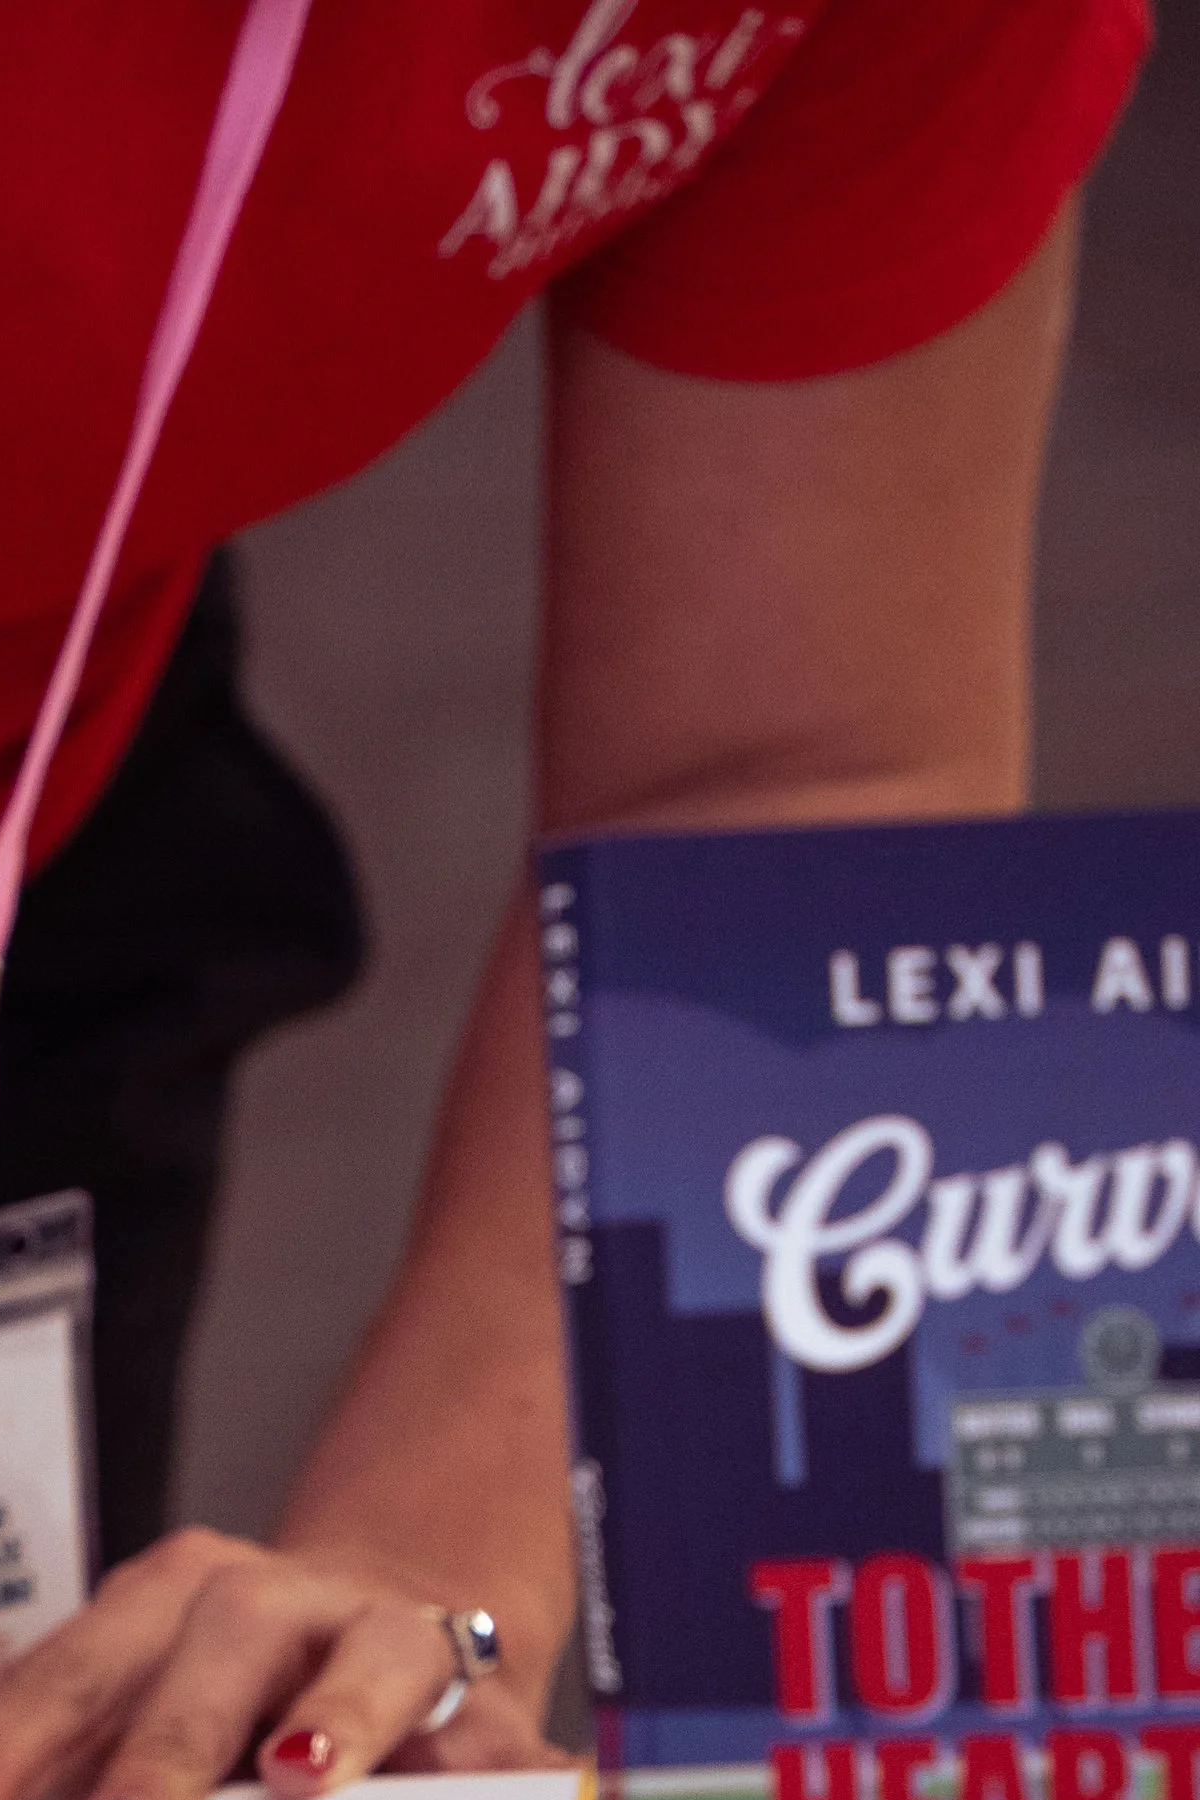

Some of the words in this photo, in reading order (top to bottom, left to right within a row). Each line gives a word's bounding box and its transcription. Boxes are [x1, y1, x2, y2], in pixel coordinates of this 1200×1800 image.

[829, 940, 1046, 1027] LEXI
[1091, 932, 1200, 1014] AI
[724, 1113, 1200, 1373] Curv
